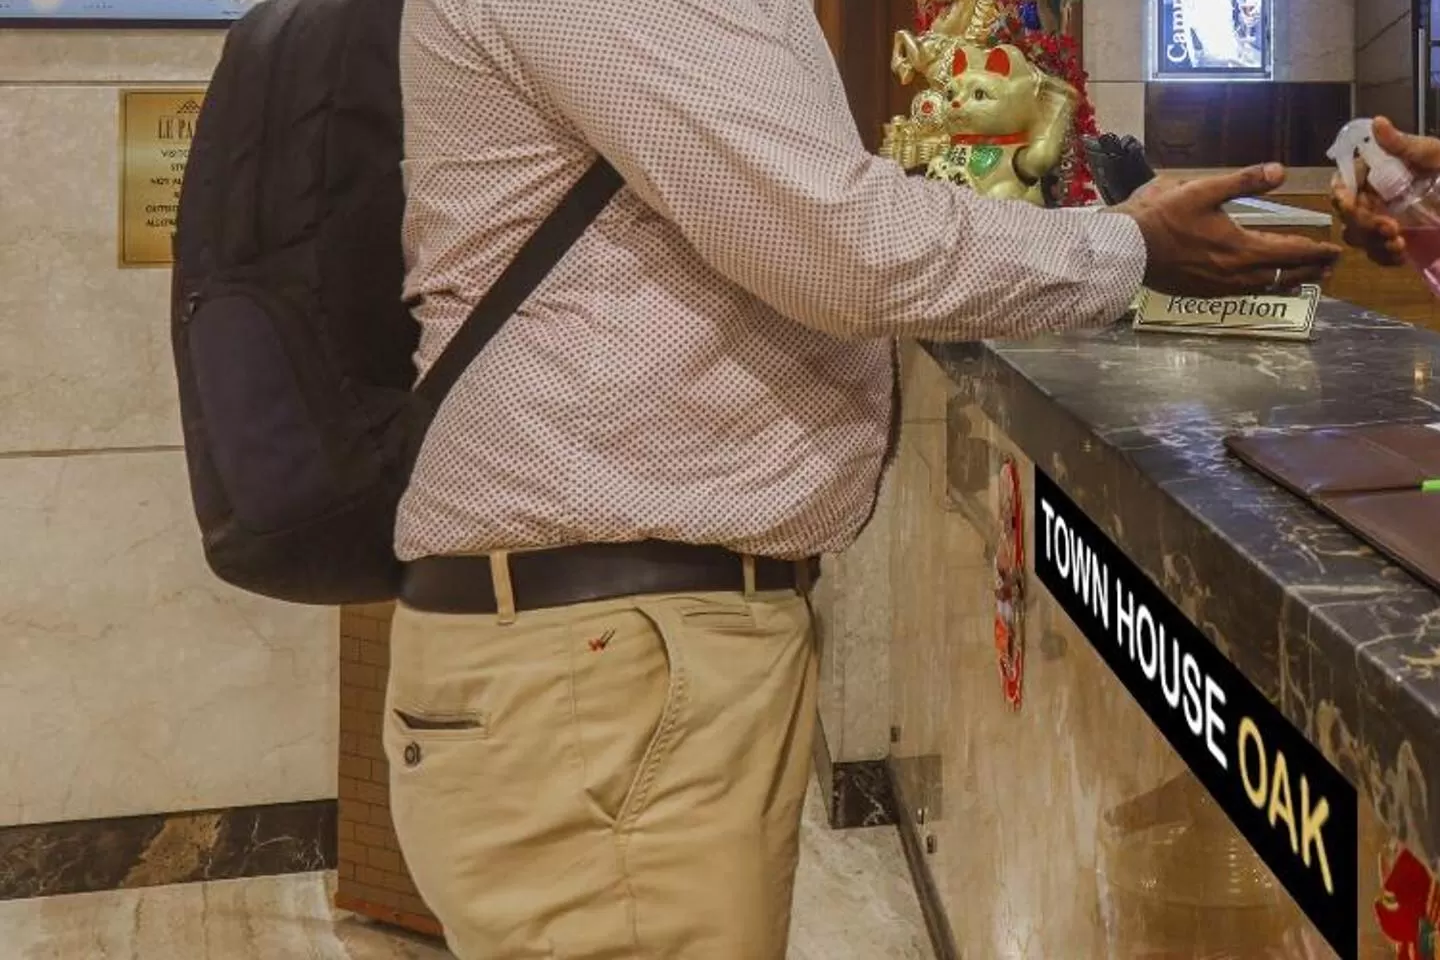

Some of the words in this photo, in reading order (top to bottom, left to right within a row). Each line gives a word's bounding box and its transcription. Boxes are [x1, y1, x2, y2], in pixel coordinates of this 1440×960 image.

[1167, 294, 1288, 323] Reception
[1041, 498, 1109, 630] TOWN
[1116, 577, 1228, 770] HOUSE
[1238, 716, 1334, 895] OAK
